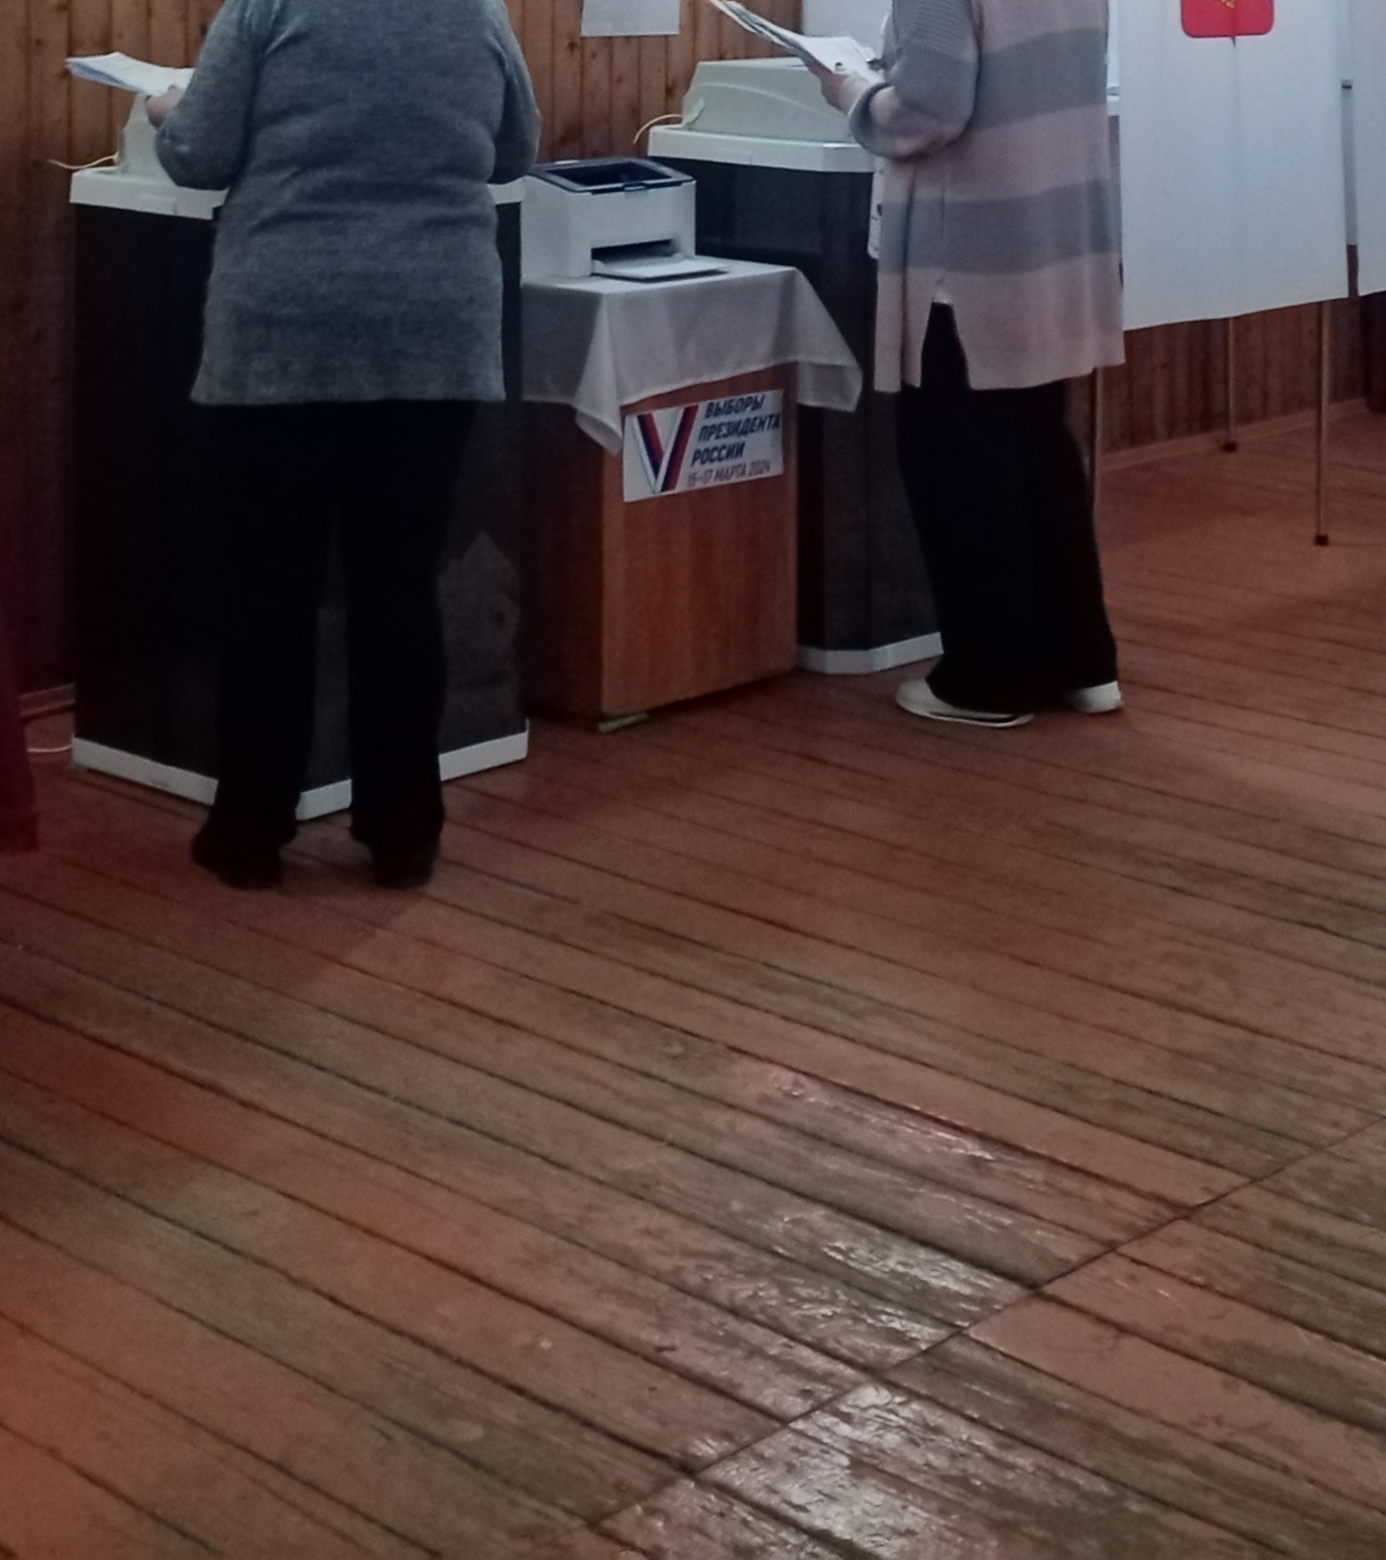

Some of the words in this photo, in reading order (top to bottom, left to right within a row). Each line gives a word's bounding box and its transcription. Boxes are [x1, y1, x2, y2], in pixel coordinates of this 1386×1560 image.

[706, 395, 765, 418] ВЫБОРЫ
[698, 413, 781, 442] ПРЕЗИДЕНТА
[691, 442, 746, 467] РОССИИ
[712, 463, 747, 482] МАРТА
